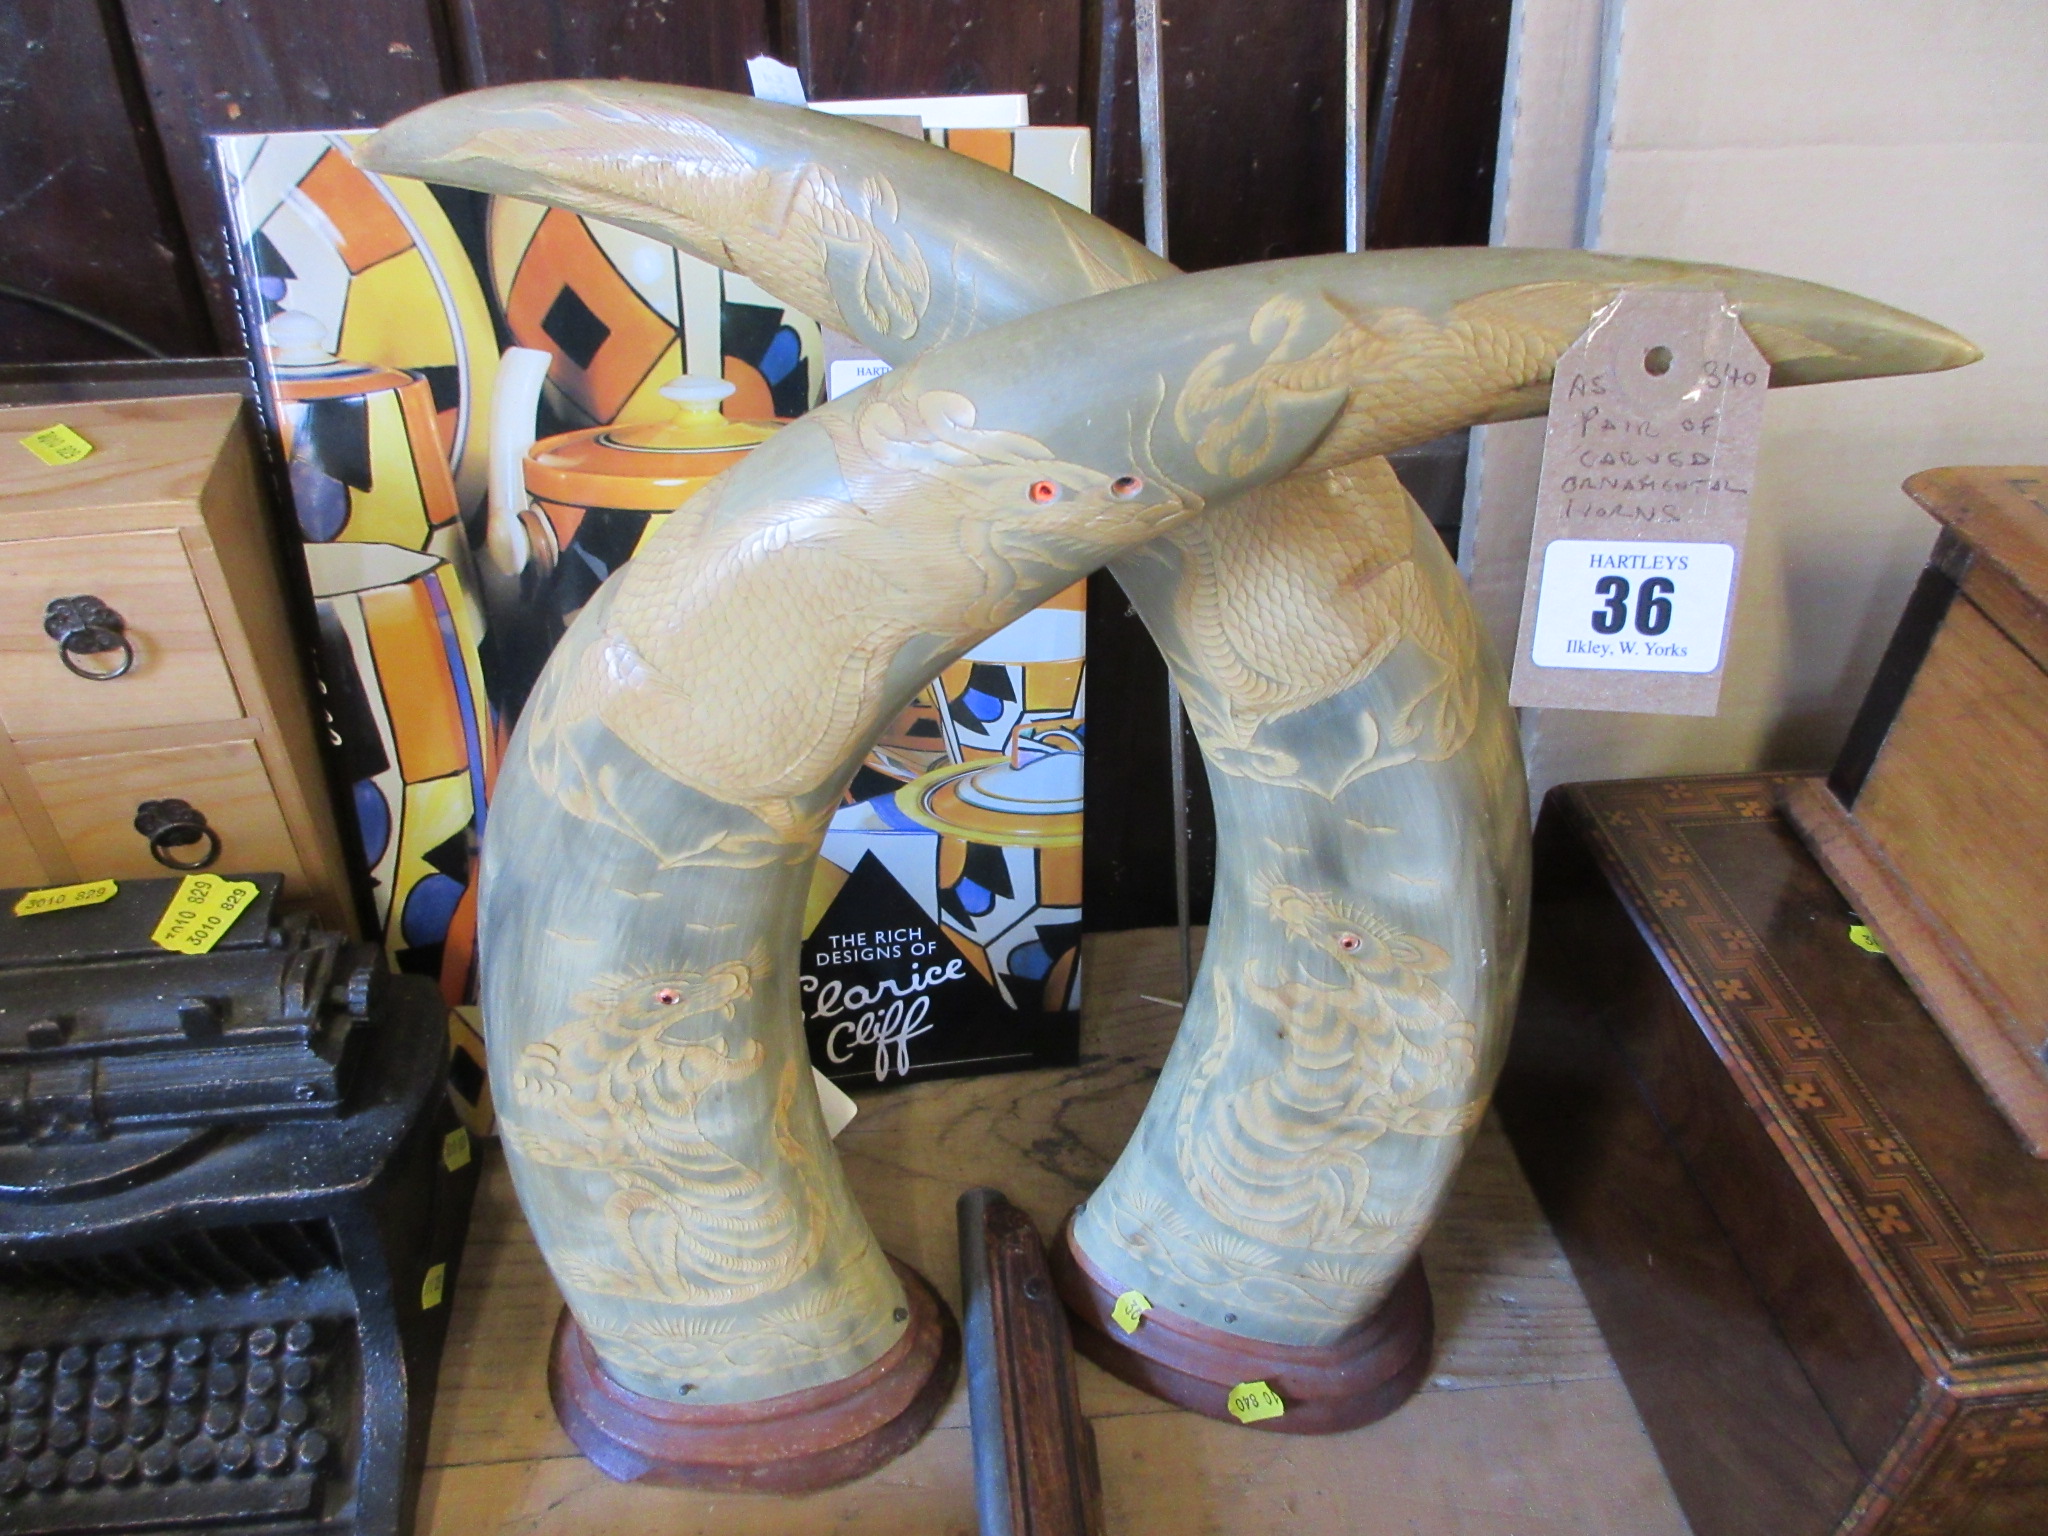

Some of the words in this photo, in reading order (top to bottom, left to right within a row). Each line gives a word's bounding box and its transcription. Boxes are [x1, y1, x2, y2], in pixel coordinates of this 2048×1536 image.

[1702, 361, 1757, 388] 840
[1568, 374, 1607, 400] AS
[1578, 406, 1659, 437] PAIR
[1681, 416, 1716, 435] OF
[1579, 451, 1711, 468] CARVED
[1589, 554, 1689, 570] HARTLEYS
[1591, 575, 1675, 636] 36
[1566, 640, 1614, 657] Ilkley,
[1619, 641, 1639, 655] W.
[1645, 642, 1688, 657] Yorks
[25, 894, 66, 910] 3010
[75, 886, 107, 902] 829
[187, 881, 212, 904] 829
[187, 916, 222, 946] 3010
[221, 888, 247, 911] 829
[829, 932, 867, 949] THE
[875, 927, 922, 944] RICH
[816, 945, 901, 966] DESIGNS
[910, 941, 937, 956] OF
[826, 996, 934, 1082] Cliff
[1235, 1393, 1259, 1412] 840
